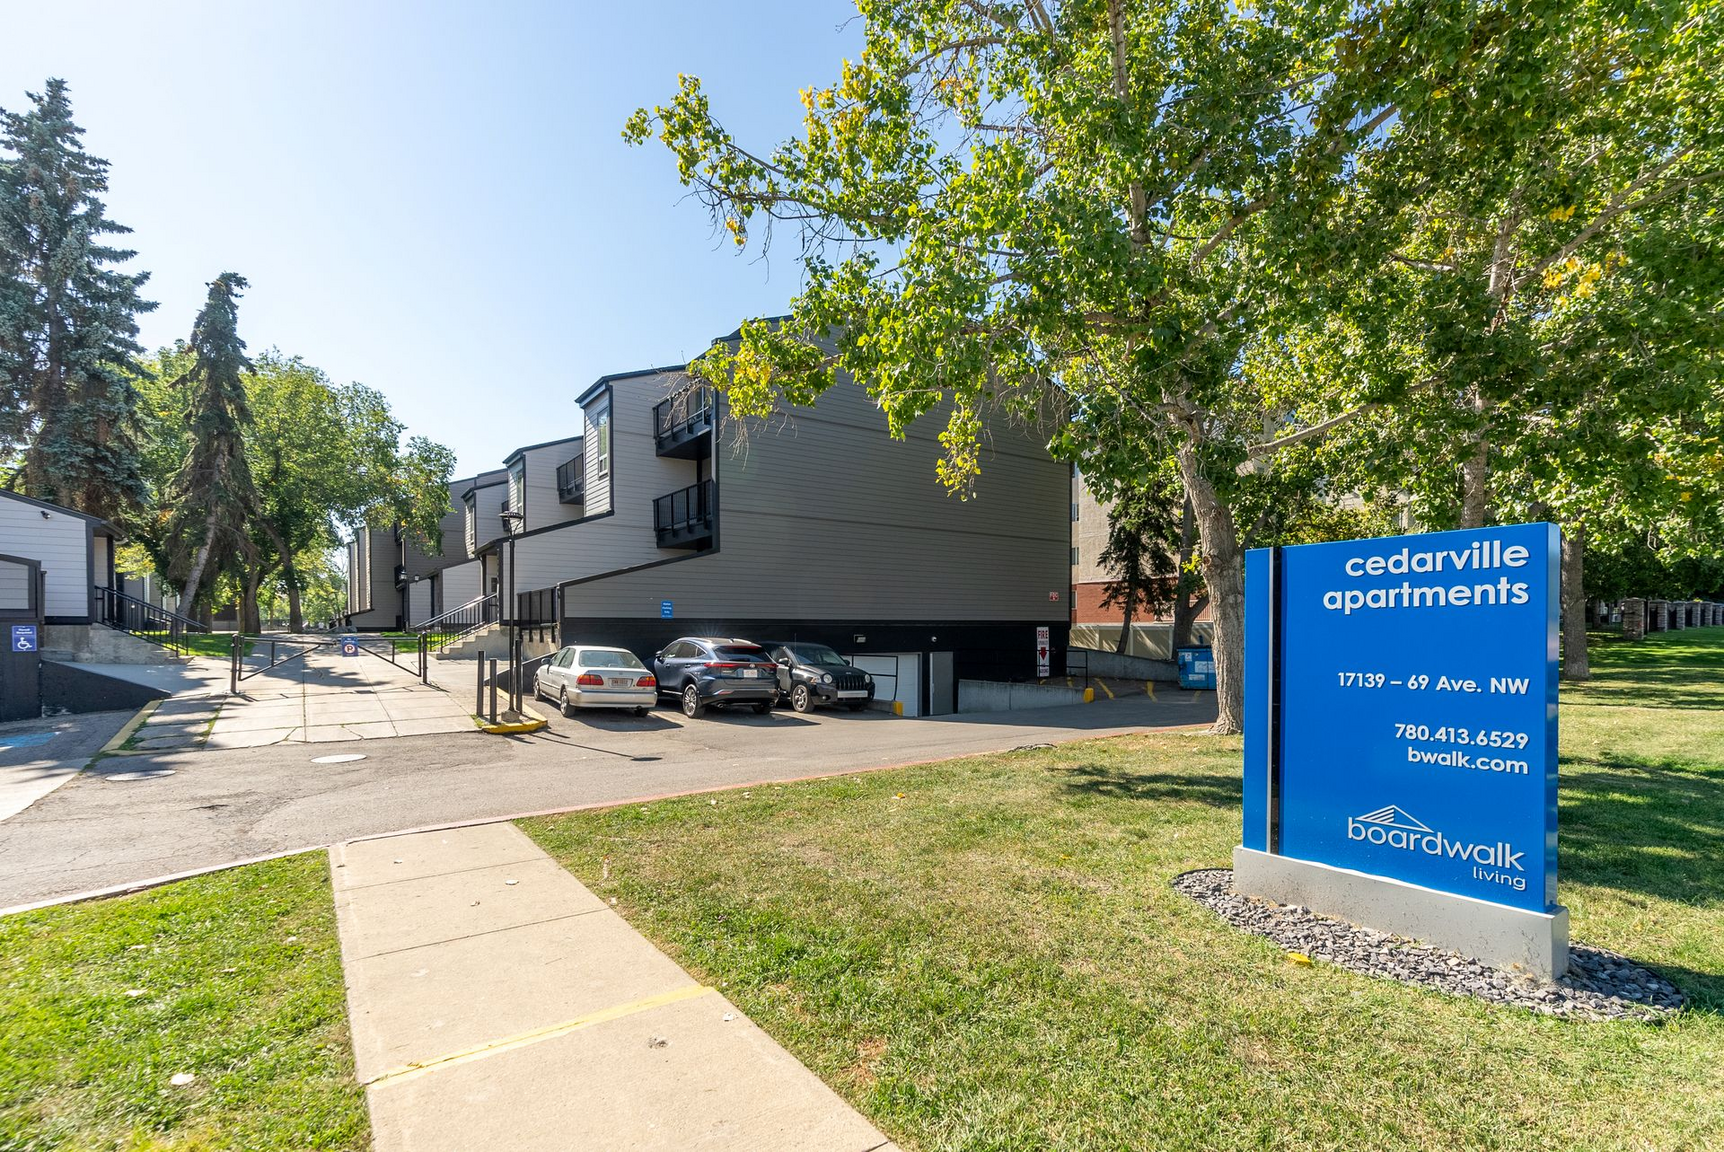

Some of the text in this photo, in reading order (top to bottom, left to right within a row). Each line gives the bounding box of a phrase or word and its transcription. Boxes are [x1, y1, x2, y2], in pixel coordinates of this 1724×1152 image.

[1345, 540, 1530, 577] cedarville
[1323, 577, 1530, 615] apartments
[1037, 630, 1049, 639] FIRE
[1338, 672, 1386, 688] 17139
[1407, 674, 1430, 690] 69
[1435, 675, 1482, 693] Ave.
[1490, 677, 1530, 695] NW
[1394, 723, 1530, 750] 780.413.6529
[1407, 746, 1530, 775] bwalk.com
[1347, 816, 1526, 872] boardwalk
[1473, 866, 1526, 891] living
